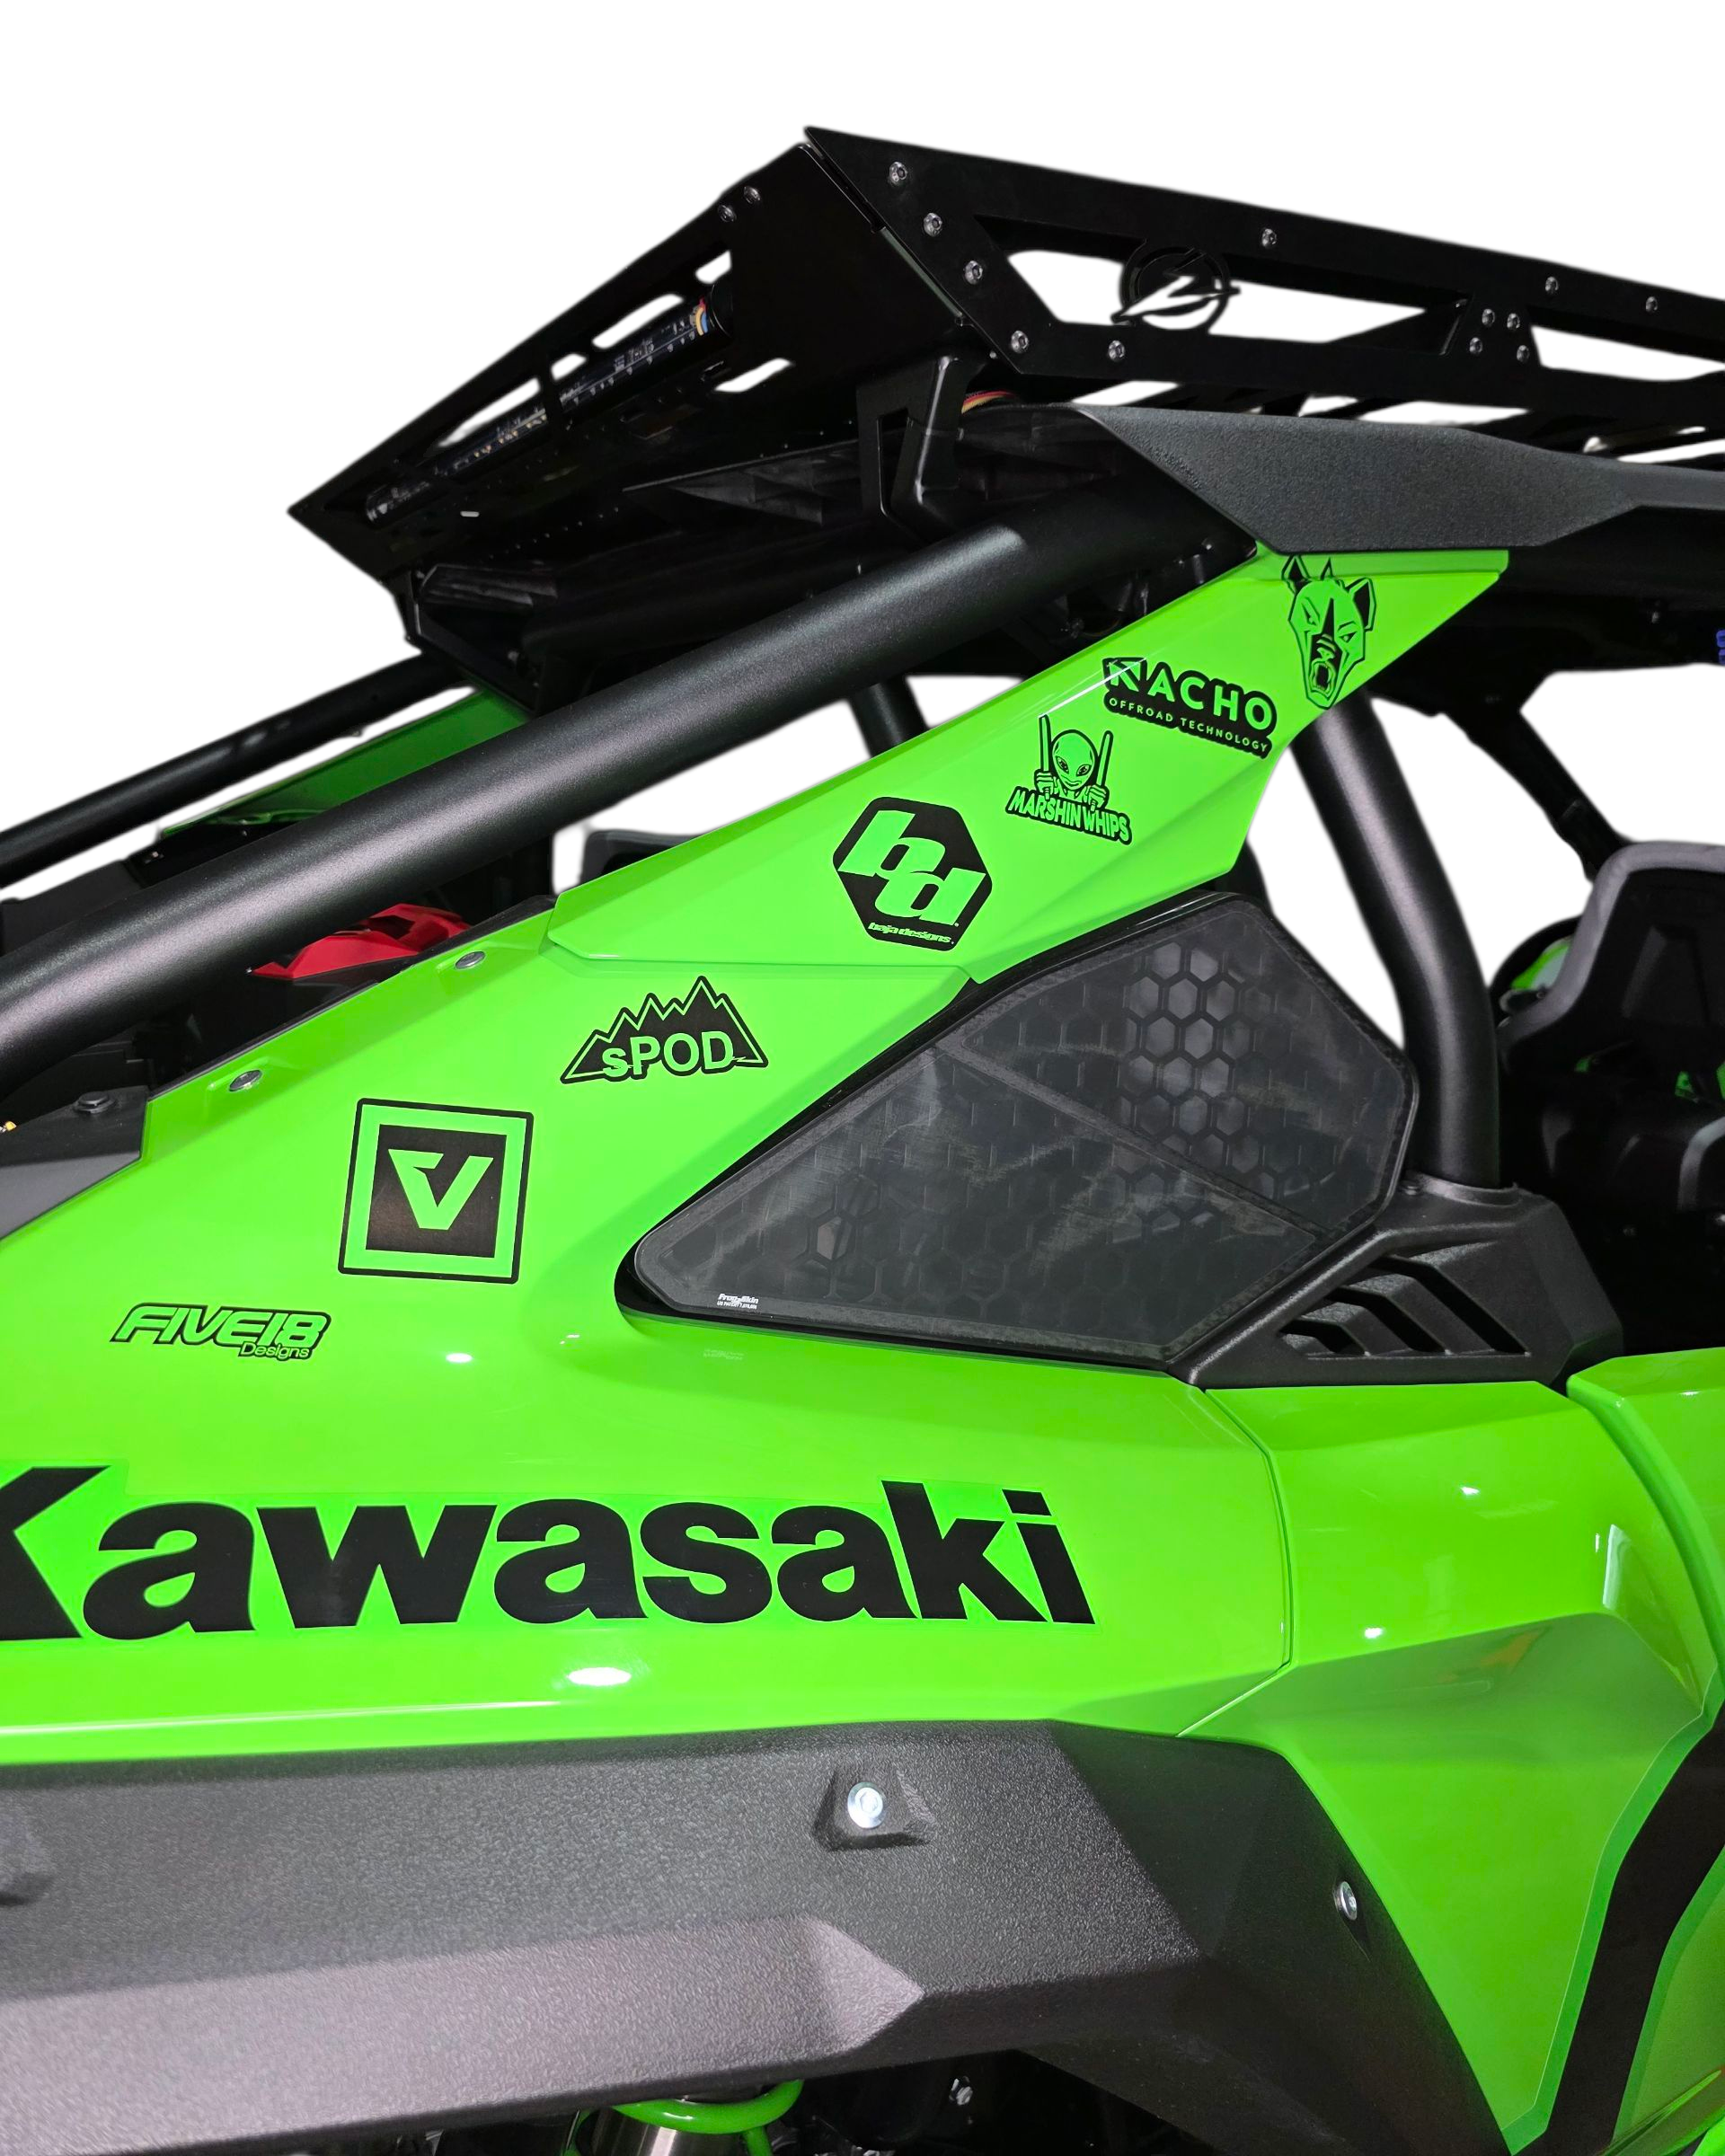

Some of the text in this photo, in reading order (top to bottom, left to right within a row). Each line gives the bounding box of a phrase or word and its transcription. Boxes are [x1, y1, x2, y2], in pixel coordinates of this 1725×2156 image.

[1109, 660, 1272, 730] NACHO
[1109, 697, 1269, 753] OFFROAD TECHNOLOGY
[111, 1303, 329, 1348] FIVE18
[239, 1342, 310, 1359] Designs
